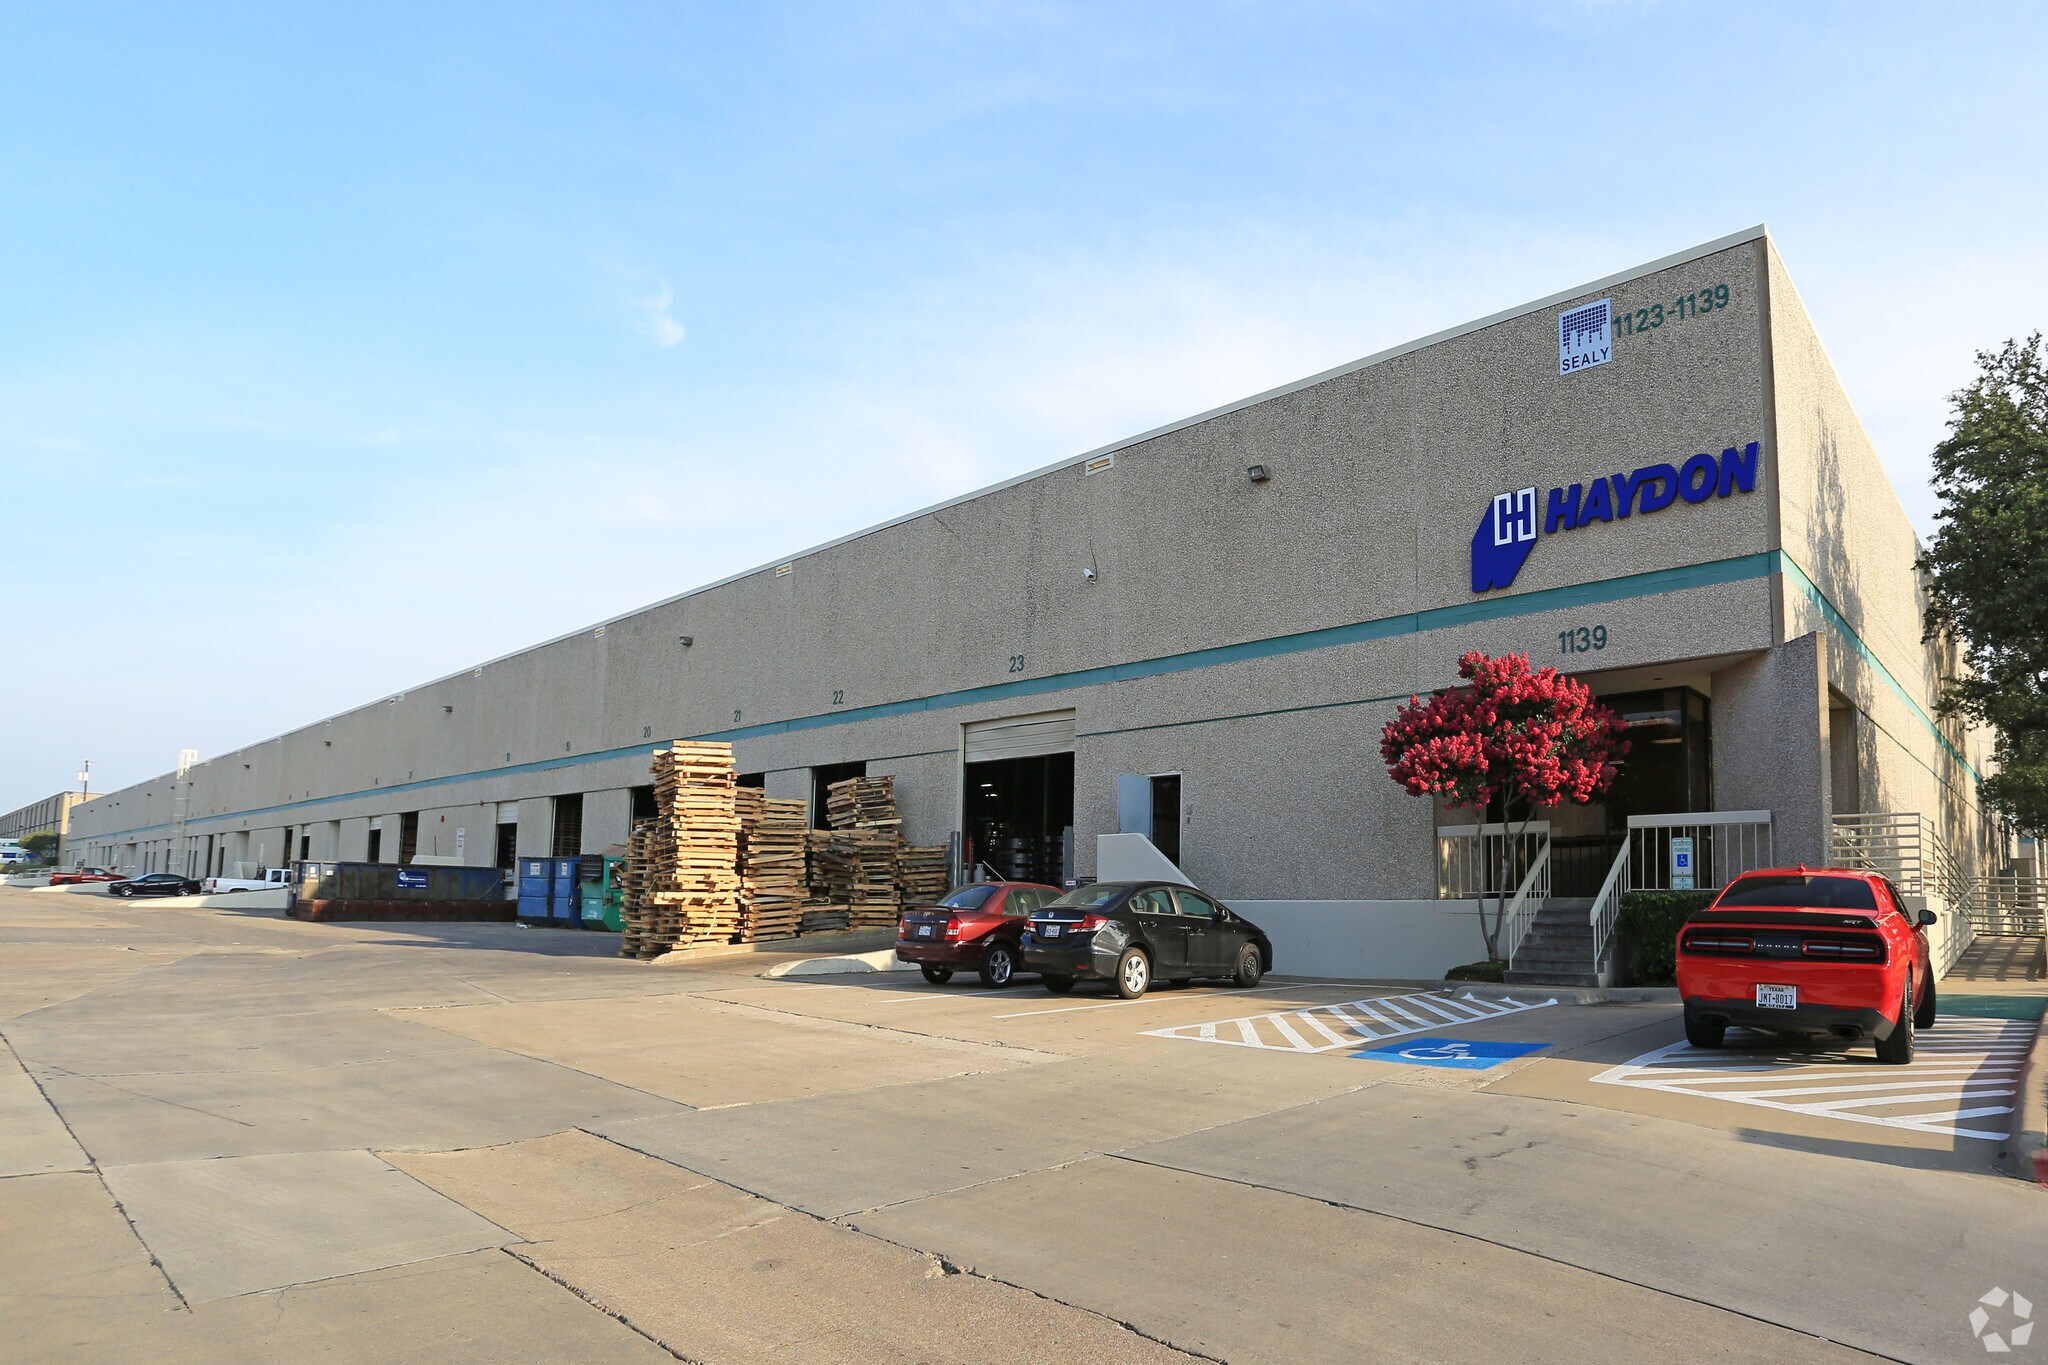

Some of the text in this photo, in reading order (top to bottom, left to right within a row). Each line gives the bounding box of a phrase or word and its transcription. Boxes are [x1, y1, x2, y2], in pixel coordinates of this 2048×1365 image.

[1614, 284, 1729, 338] 1123-1139
[1562, 347, 1609, 372] SEALY
[1544, 441, 1760, 534] HAYDON
[1558, 625, 1608, 654] 1139
[1009, 654, 1025, 673] 23
[833, 690, 844, 705] 22
[733, 709, 742, 723] 21
[643, 726, 652, 738] 20
